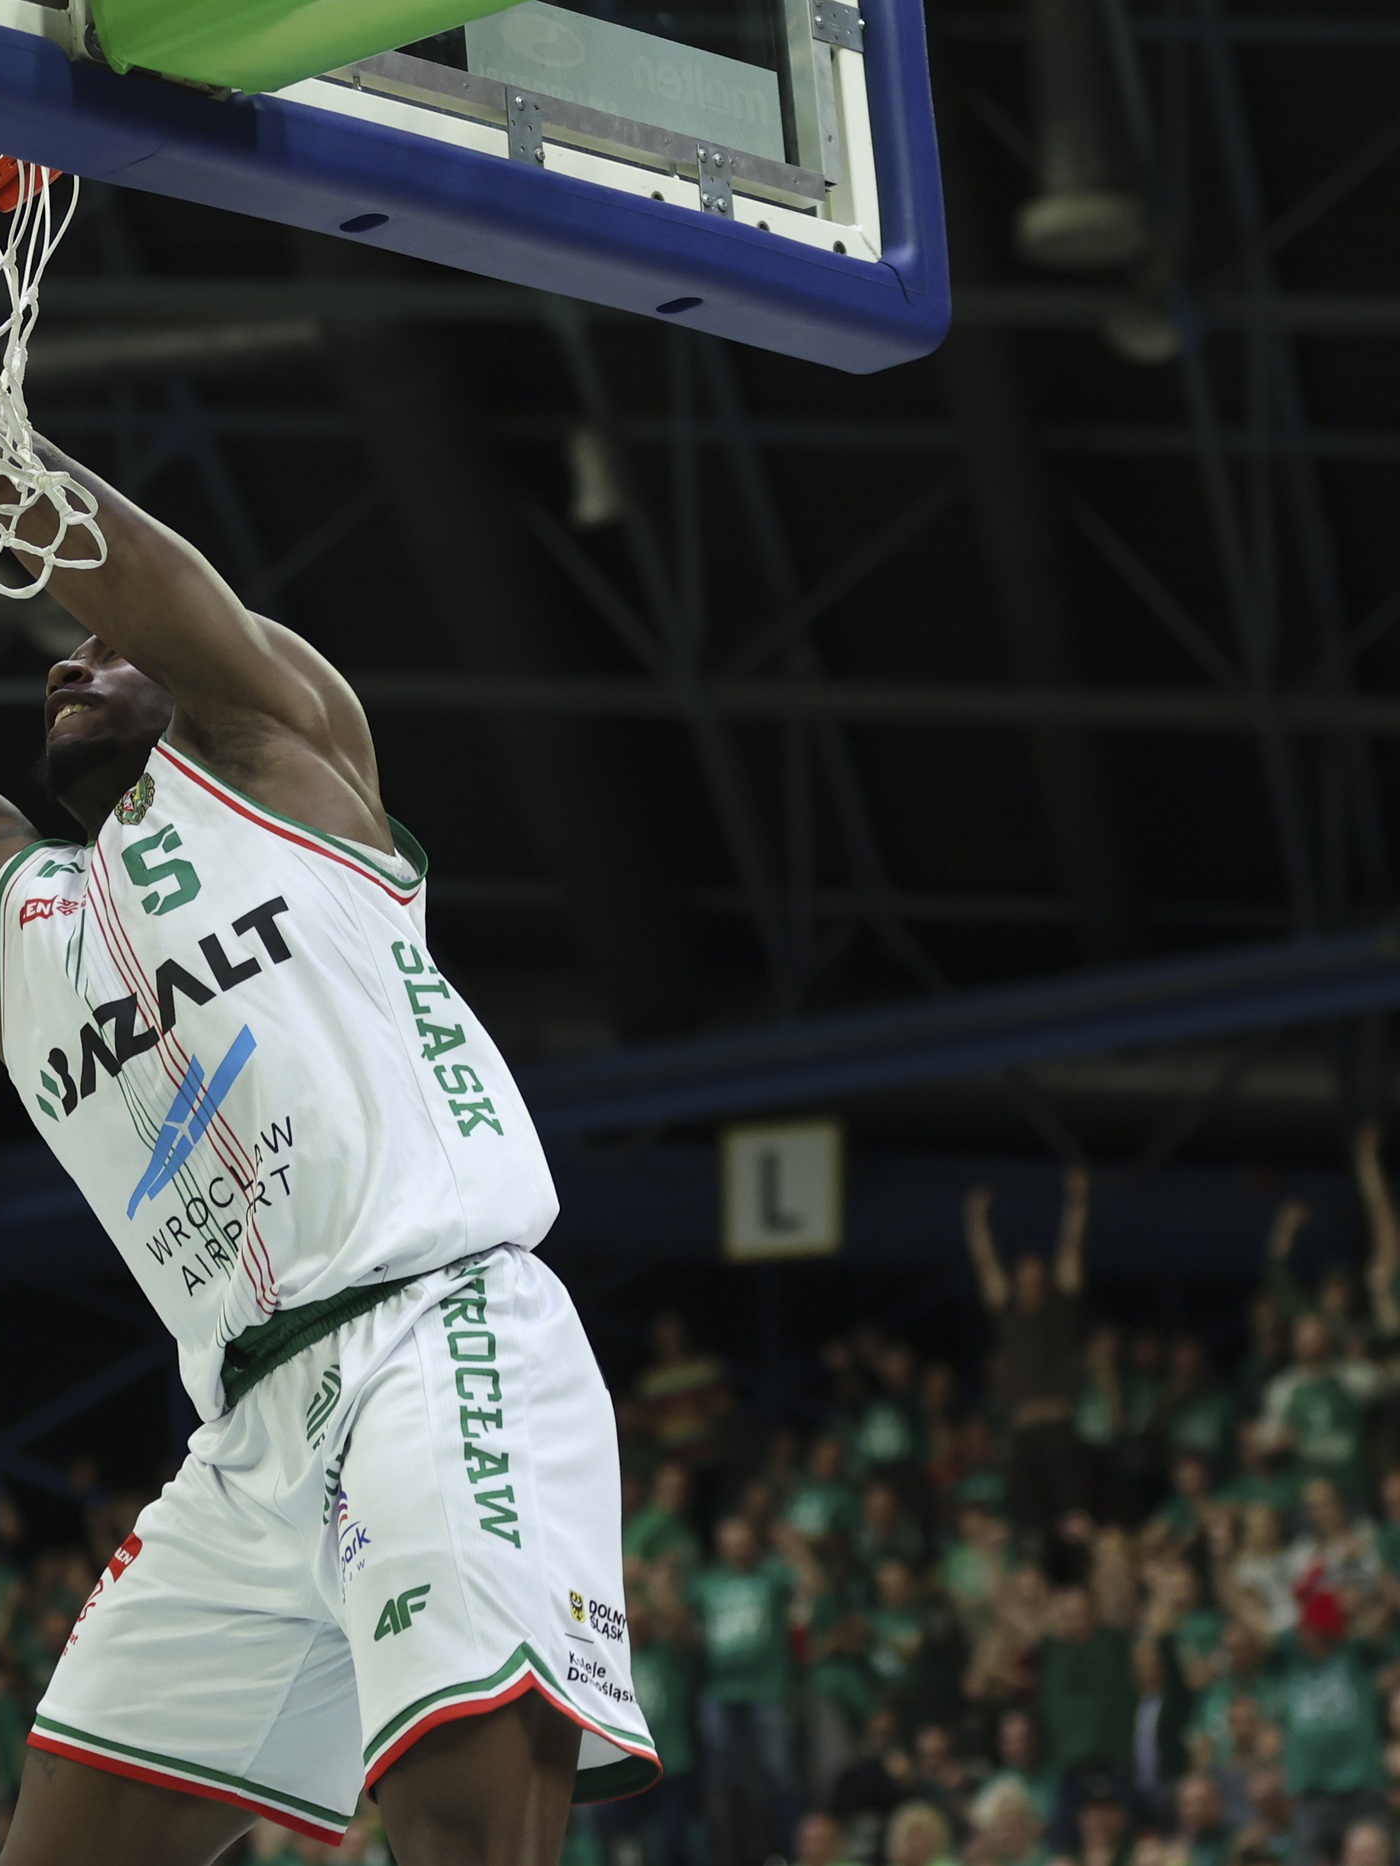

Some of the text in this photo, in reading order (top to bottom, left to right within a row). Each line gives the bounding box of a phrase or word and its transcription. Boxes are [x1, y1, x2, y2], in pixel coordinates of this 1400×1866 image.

[121, 824, 201, 916] 5
[36, 895, 293, 1122] BAZALT
[758, 1151, 805, 1235] L
[589, 1599, 626, 1629] DOLNY
